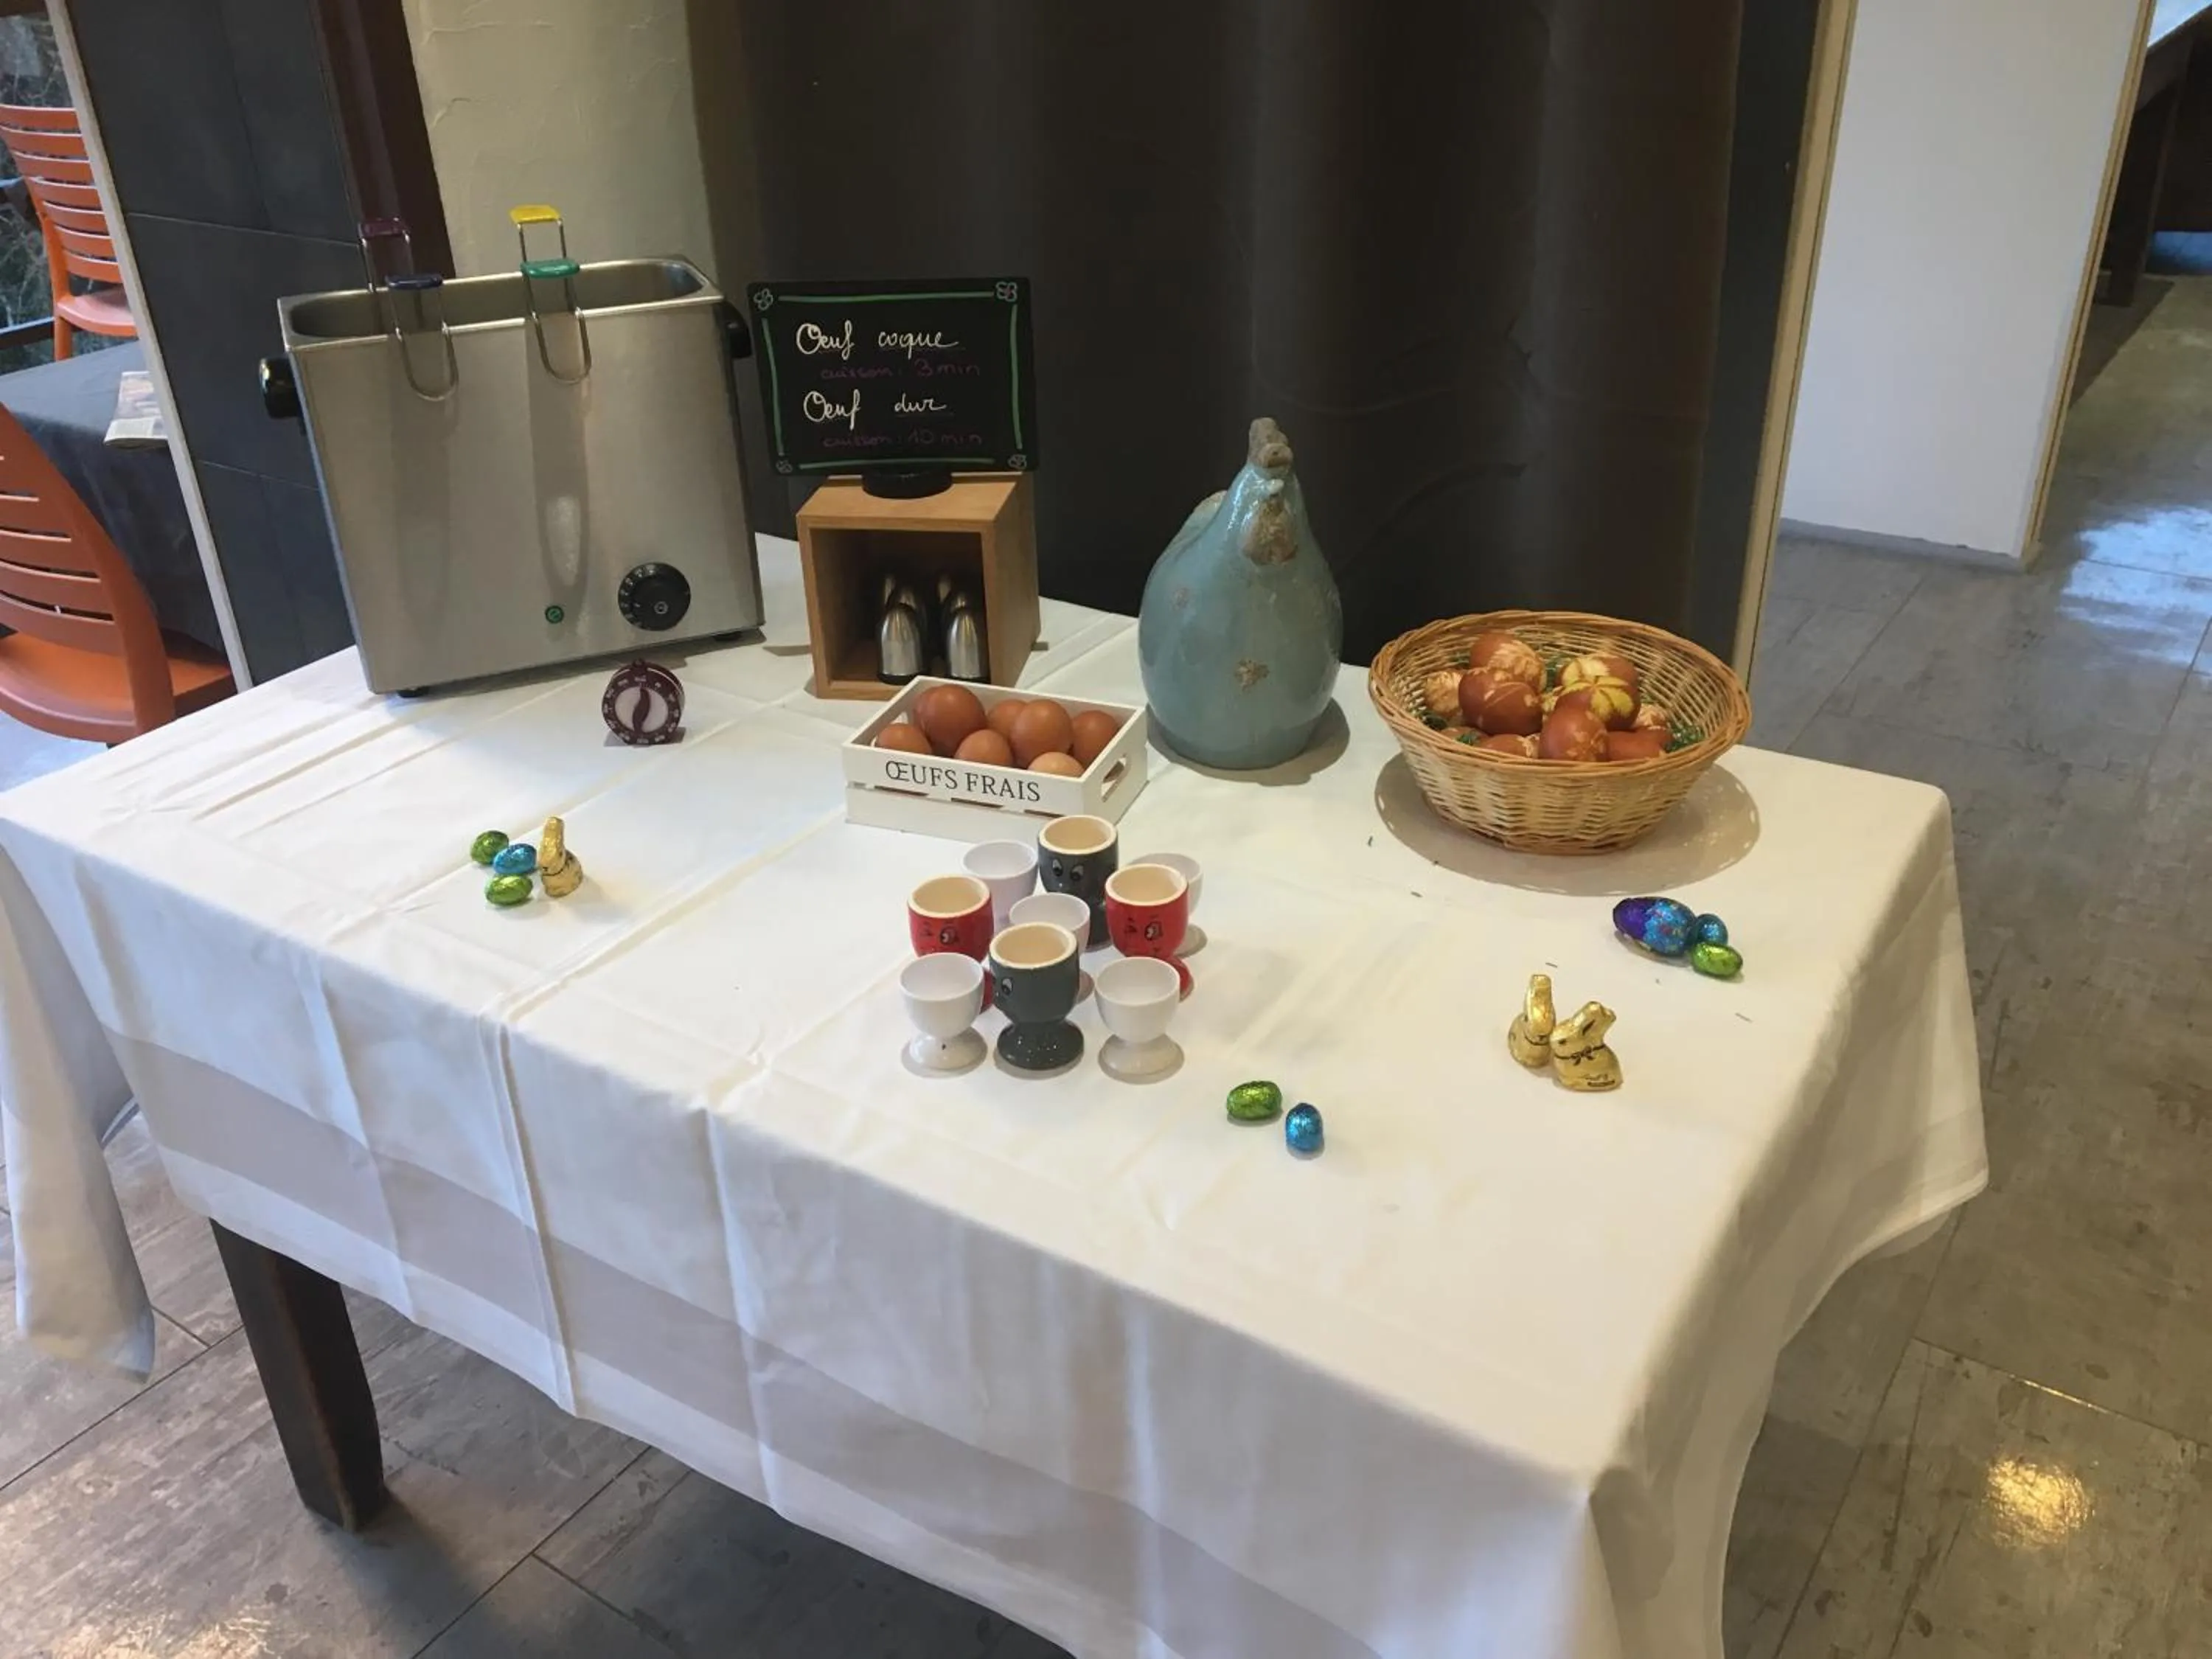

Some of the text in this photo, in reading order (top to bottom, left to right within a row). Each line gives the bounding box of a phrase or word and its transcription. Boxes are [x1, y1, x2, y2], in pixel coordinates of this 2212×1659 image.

[878, 330, 959, 359] coque
[894, 393, 947, 413] dur
[885, 760, 1040, 802] ŒUFS FRAIS
